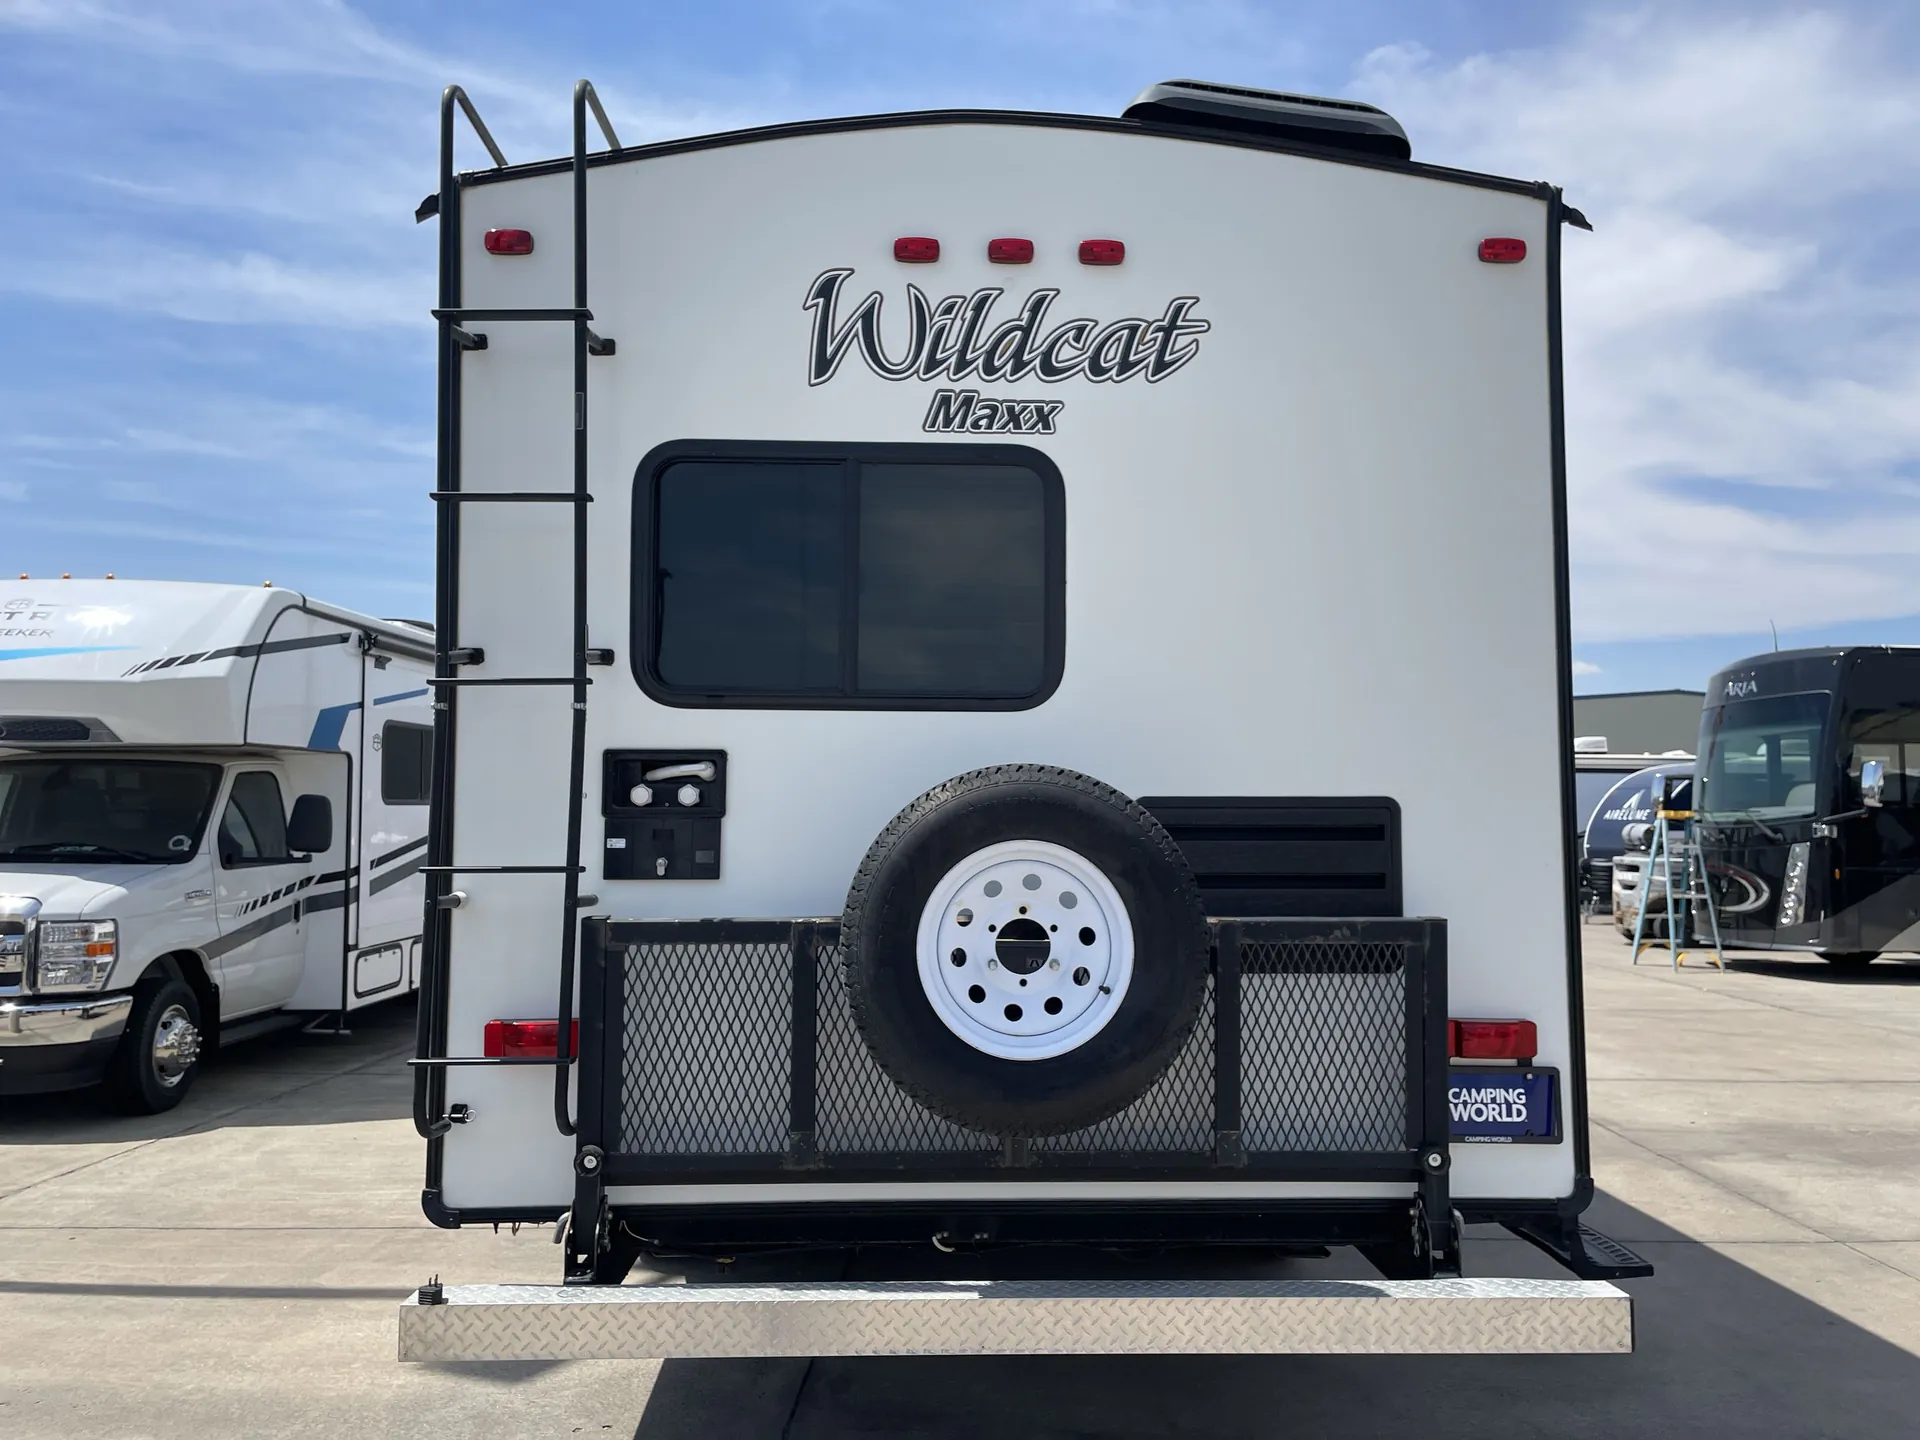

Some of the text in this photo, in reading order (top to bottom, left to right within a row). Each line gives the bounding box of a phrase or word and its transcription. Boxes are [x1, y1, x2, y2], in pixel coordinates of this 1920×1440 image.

[803, 268, 1210, 386] Wildcat
[922, 389, 1064, 434] Maxx
[1723, 680, 1758, 697] ARIA
[1448, 1087, 1527, 1104] CAMPING
[1449, 1103, 1528, 1122] WORLD
